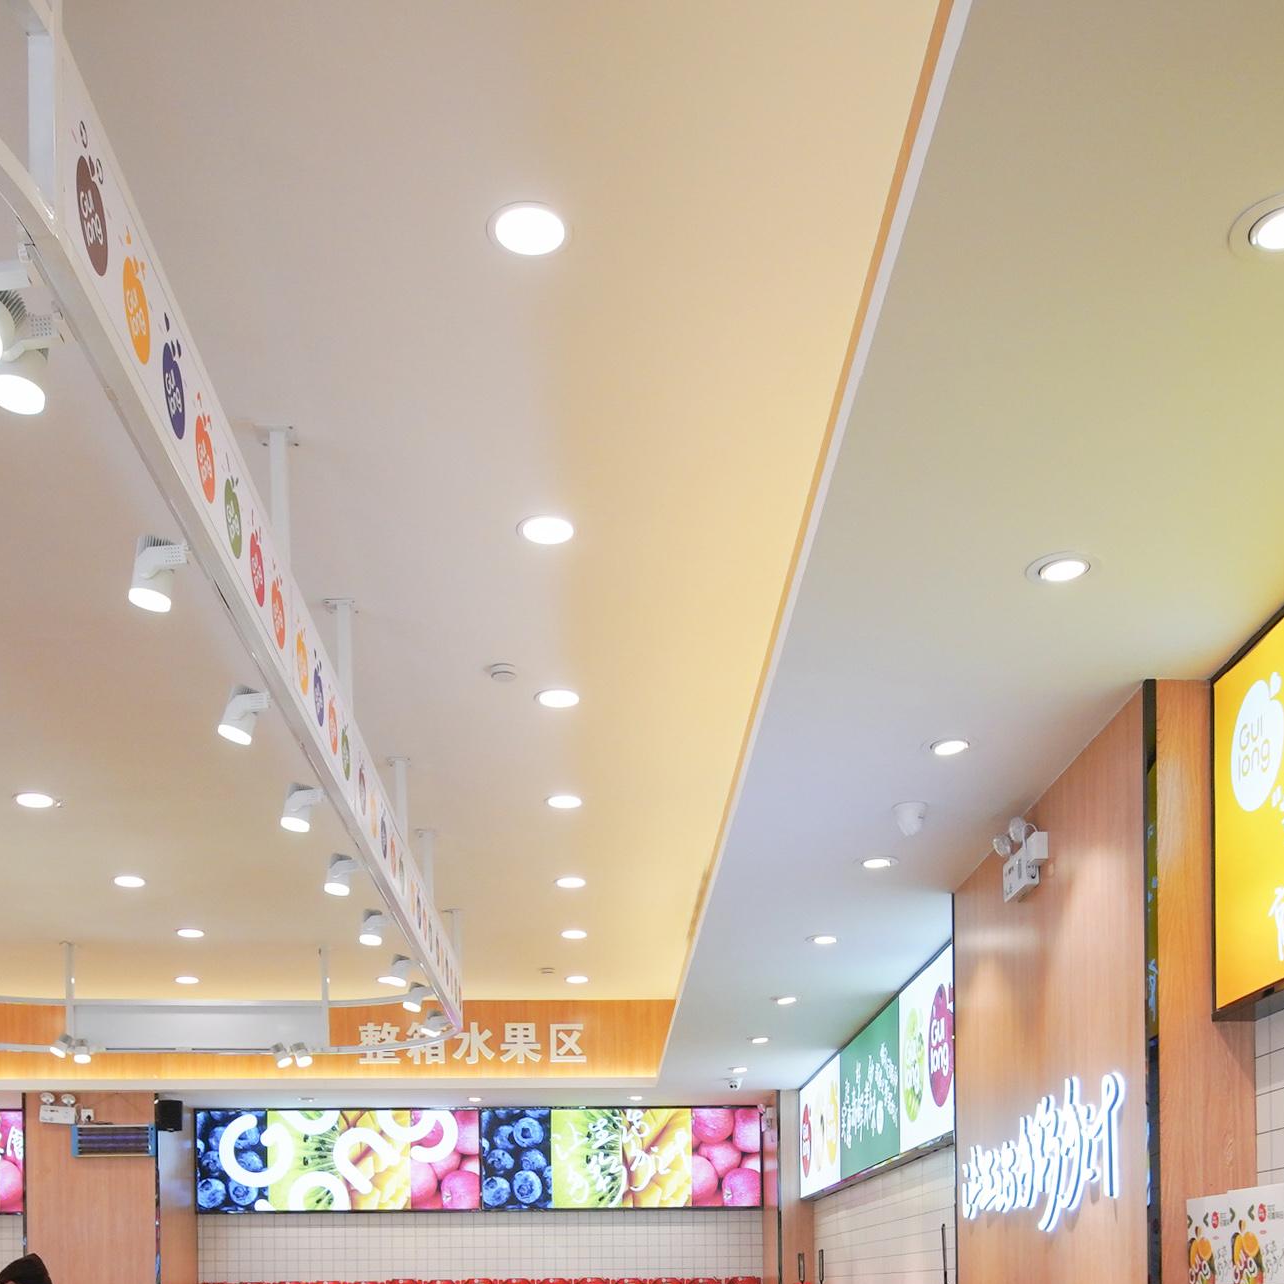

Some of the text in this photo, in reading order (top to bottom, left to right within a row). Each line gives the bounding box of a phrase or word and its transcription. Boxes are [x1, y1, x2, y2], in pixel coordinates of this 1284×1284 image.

[79, 191, 95, 217] Gui
[84, 216, 102, 246] long
[1240, 713, 1263, 748] Gui
[1238, 746, 1271, 781] long
[358, 1023, 588, 1065] 整箱水果区
[930, 1017, 945, 1047] Gui
[930, 1042, 949, 1077] long
[1233, 1252, 1246, 1284] Gui
